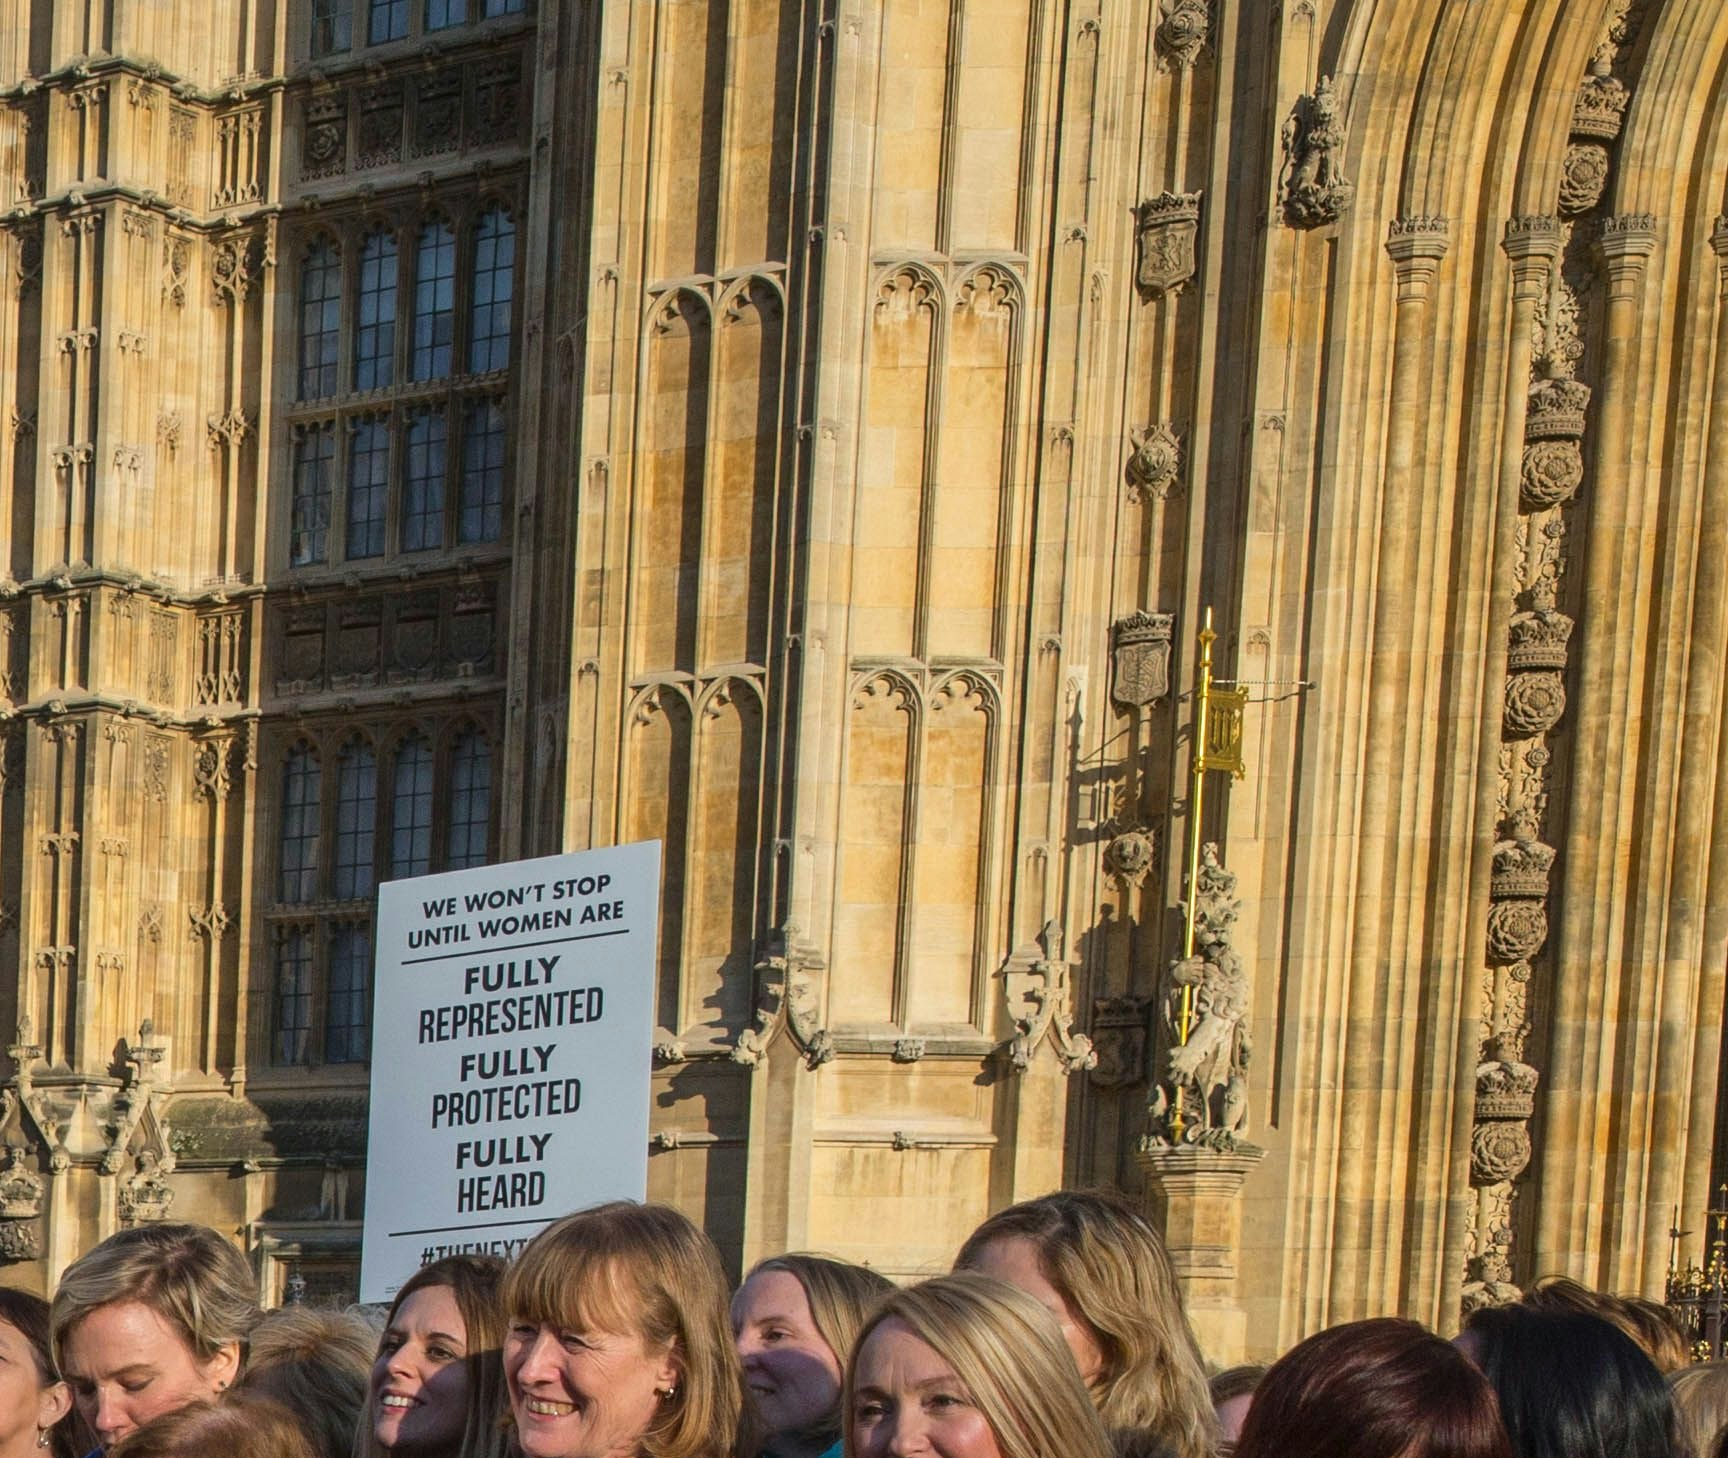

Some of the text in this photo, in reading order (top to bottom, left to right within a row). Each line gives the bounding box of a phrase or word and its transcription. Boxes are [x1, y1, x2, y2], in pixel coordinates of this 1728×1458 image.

[423, 875, 610, 918] WE WON'T STOP
[409, 901, 623, 949] UNTIL WOMEN ARE
[465, 956, 560, 994] FULLY
[419, 987, 603, 1044] REPRESENTED
[461, 1044, 556, 1082] FULLY
[432, 1079, 580, 1128] PROTECTED
[456, 1133, 552, 1169] FULLY
[458, 1171, 545, 1213] HEARD
